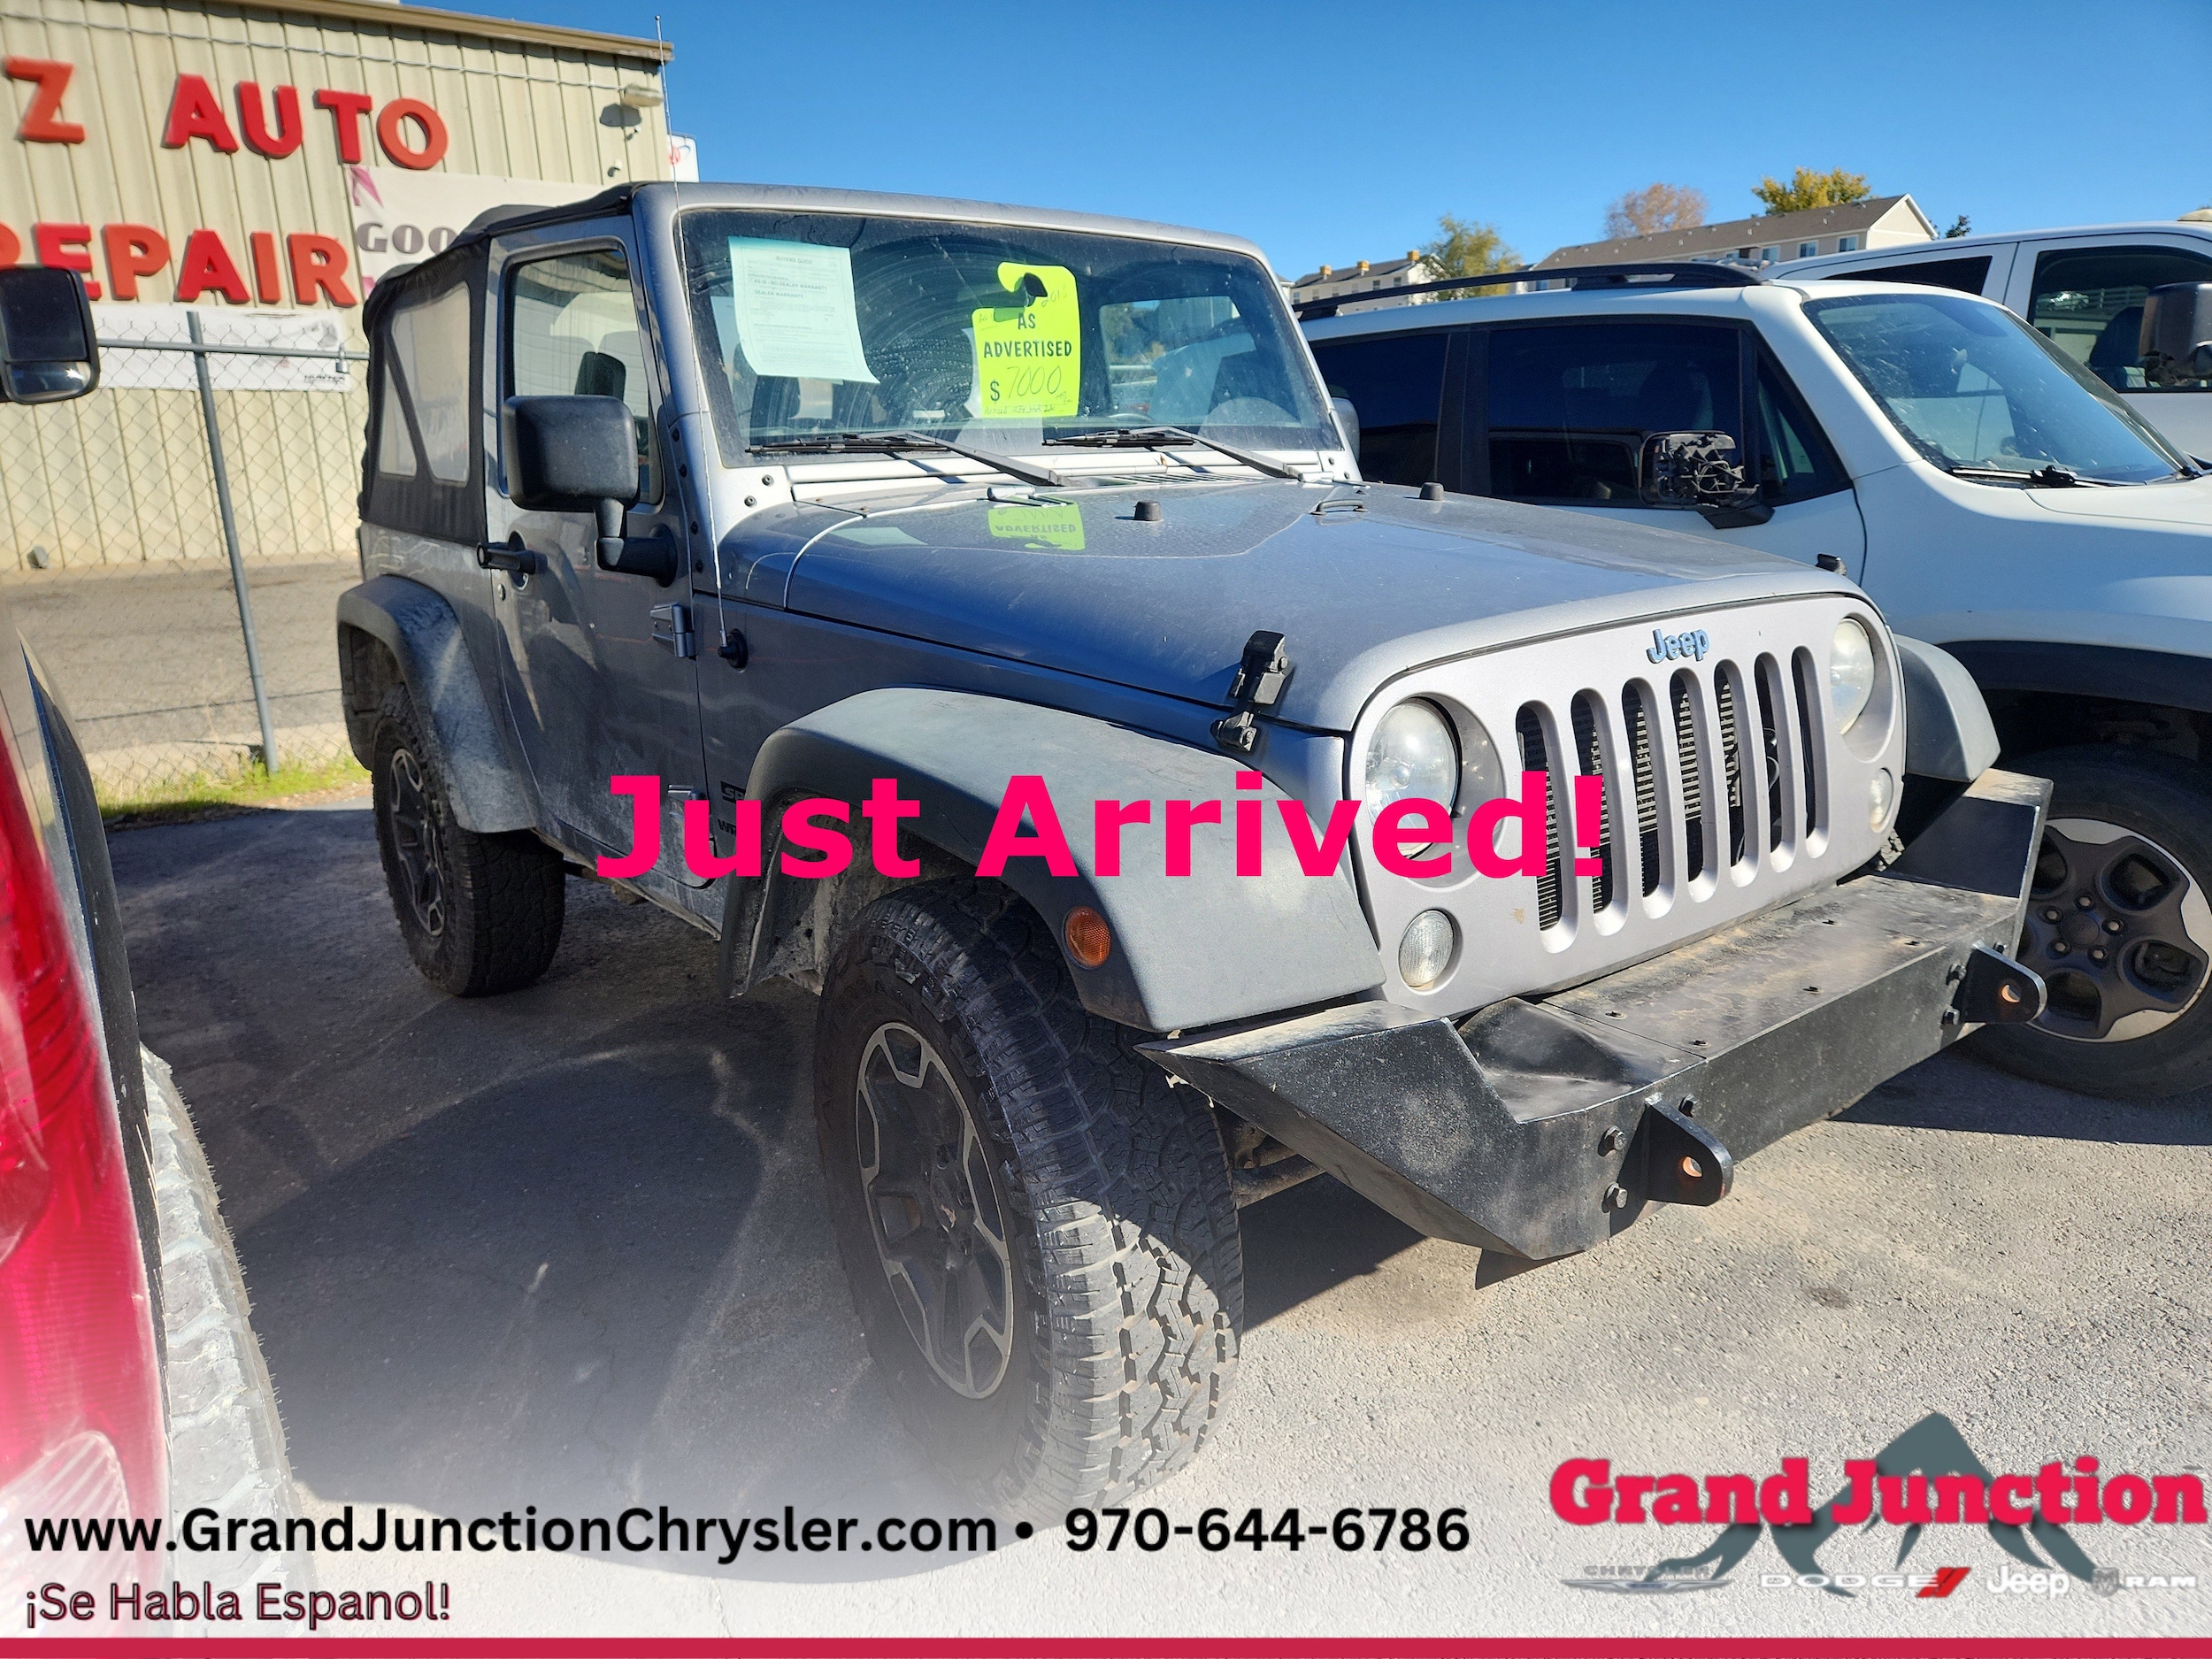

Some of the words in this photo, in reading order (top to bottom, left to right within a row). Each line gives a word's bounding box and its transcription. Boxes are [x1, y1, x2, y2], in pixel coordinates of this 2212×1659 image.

[3, 55, 86, 144] Z
[161, 73, 449, 170] AUTO
[1018, 312, 1036, 330] AS
[983, 341, 1072, 358] ADVERTISED
[989, 379, 1001, 403] $
[1007, 365, 1062, 399] 7000
[1646, 628, 1710, 664] Jeep
